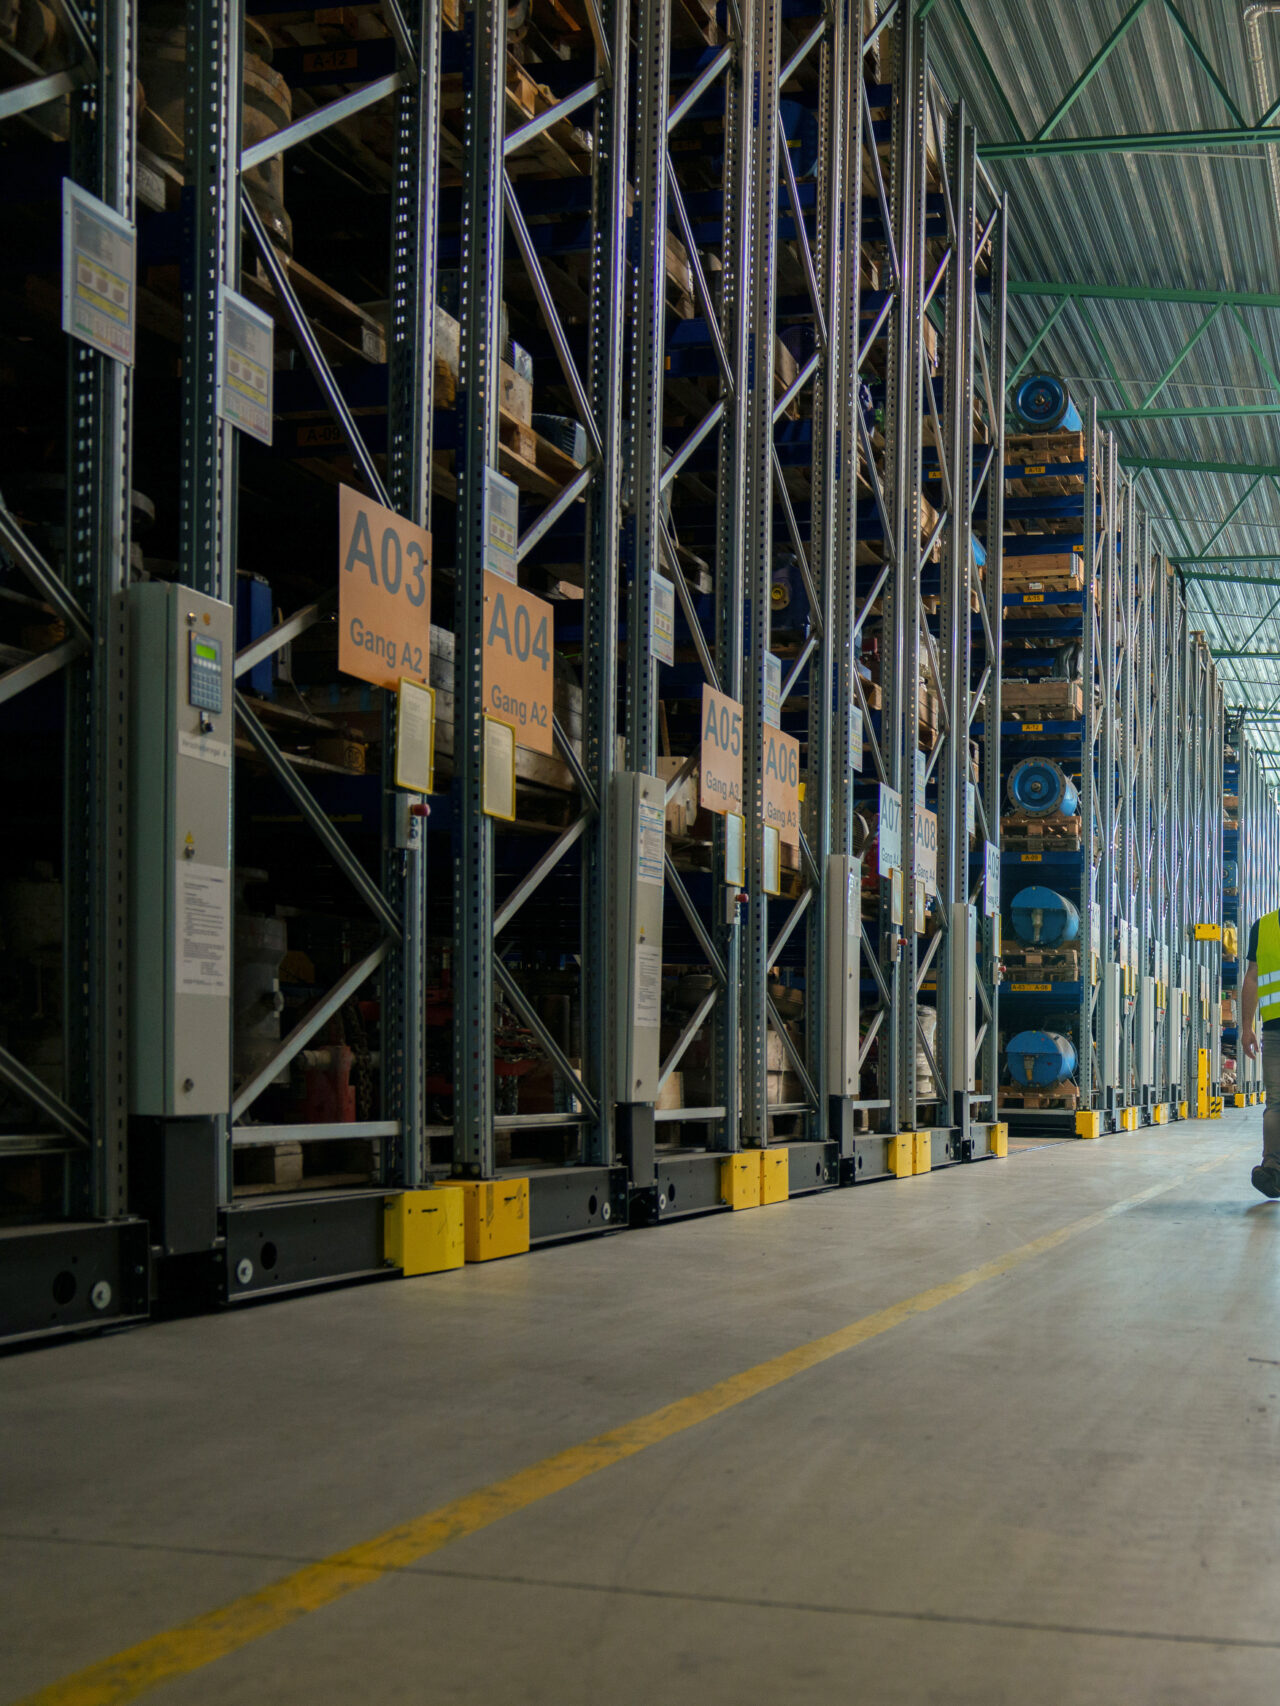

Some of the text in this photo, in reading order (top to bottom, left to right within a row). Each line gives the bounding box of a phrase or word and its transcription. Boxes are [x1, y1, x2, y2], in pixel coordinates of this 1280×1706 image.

[313, 52, 347, 69] A-12
[345, 510, 426, 607] A03
[350, 617, 423, 674] Gang A2
[487, 593, 550, 671] A04
[491, 684, 548, 728] Gang A2
[704, 698, 741, 757] A05
[765, 737, 797, 788] A06
[705, 770, 740, 802] Gang A3
[767, 801, 797, 828] Gang A3
[881, 793, 900, 833] A07
[916, 814, 936, 852] A08
[881, 847, 893, 868] Gang
[917, 863, 928, 883] Gang
